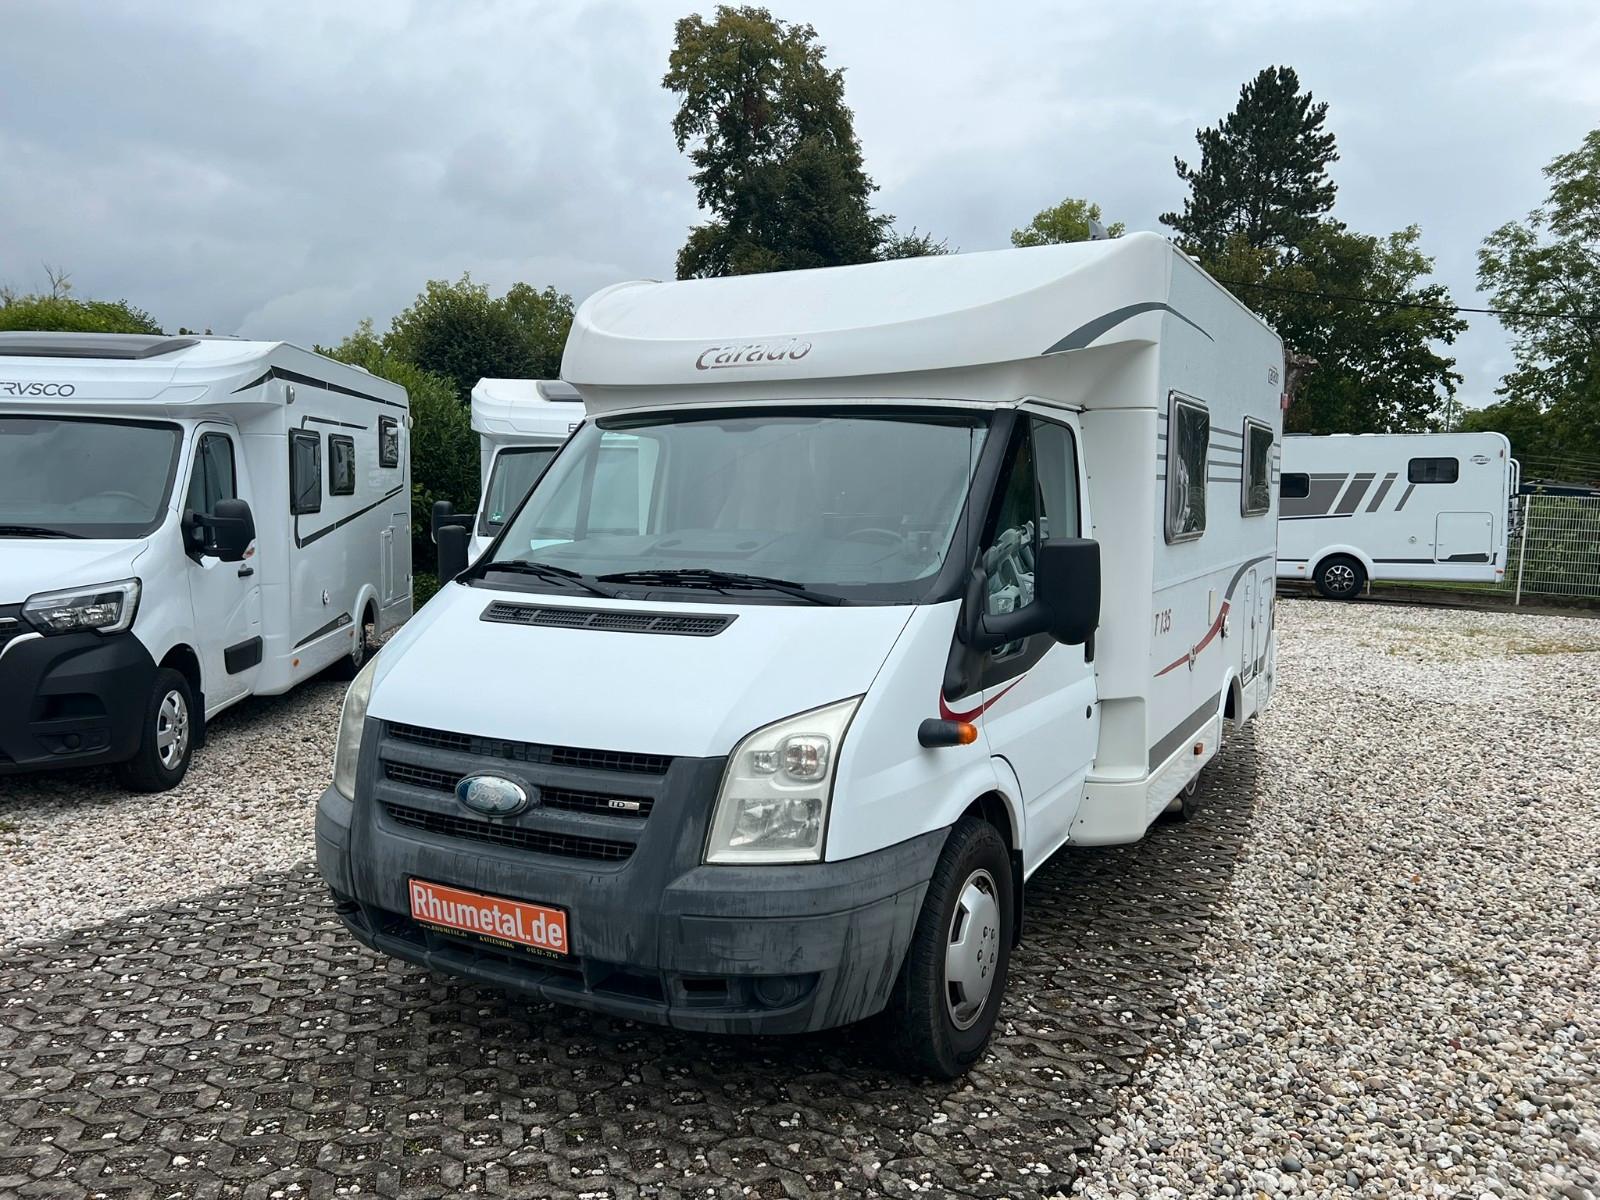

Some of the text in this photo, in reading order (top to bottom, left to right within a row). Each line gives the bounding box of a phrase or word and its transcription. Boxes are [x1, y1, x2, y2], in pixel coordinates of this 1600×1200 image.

[1154, 608, 1172, 637] T 135
[412, 885, 563, 947] Rhumetal.de
